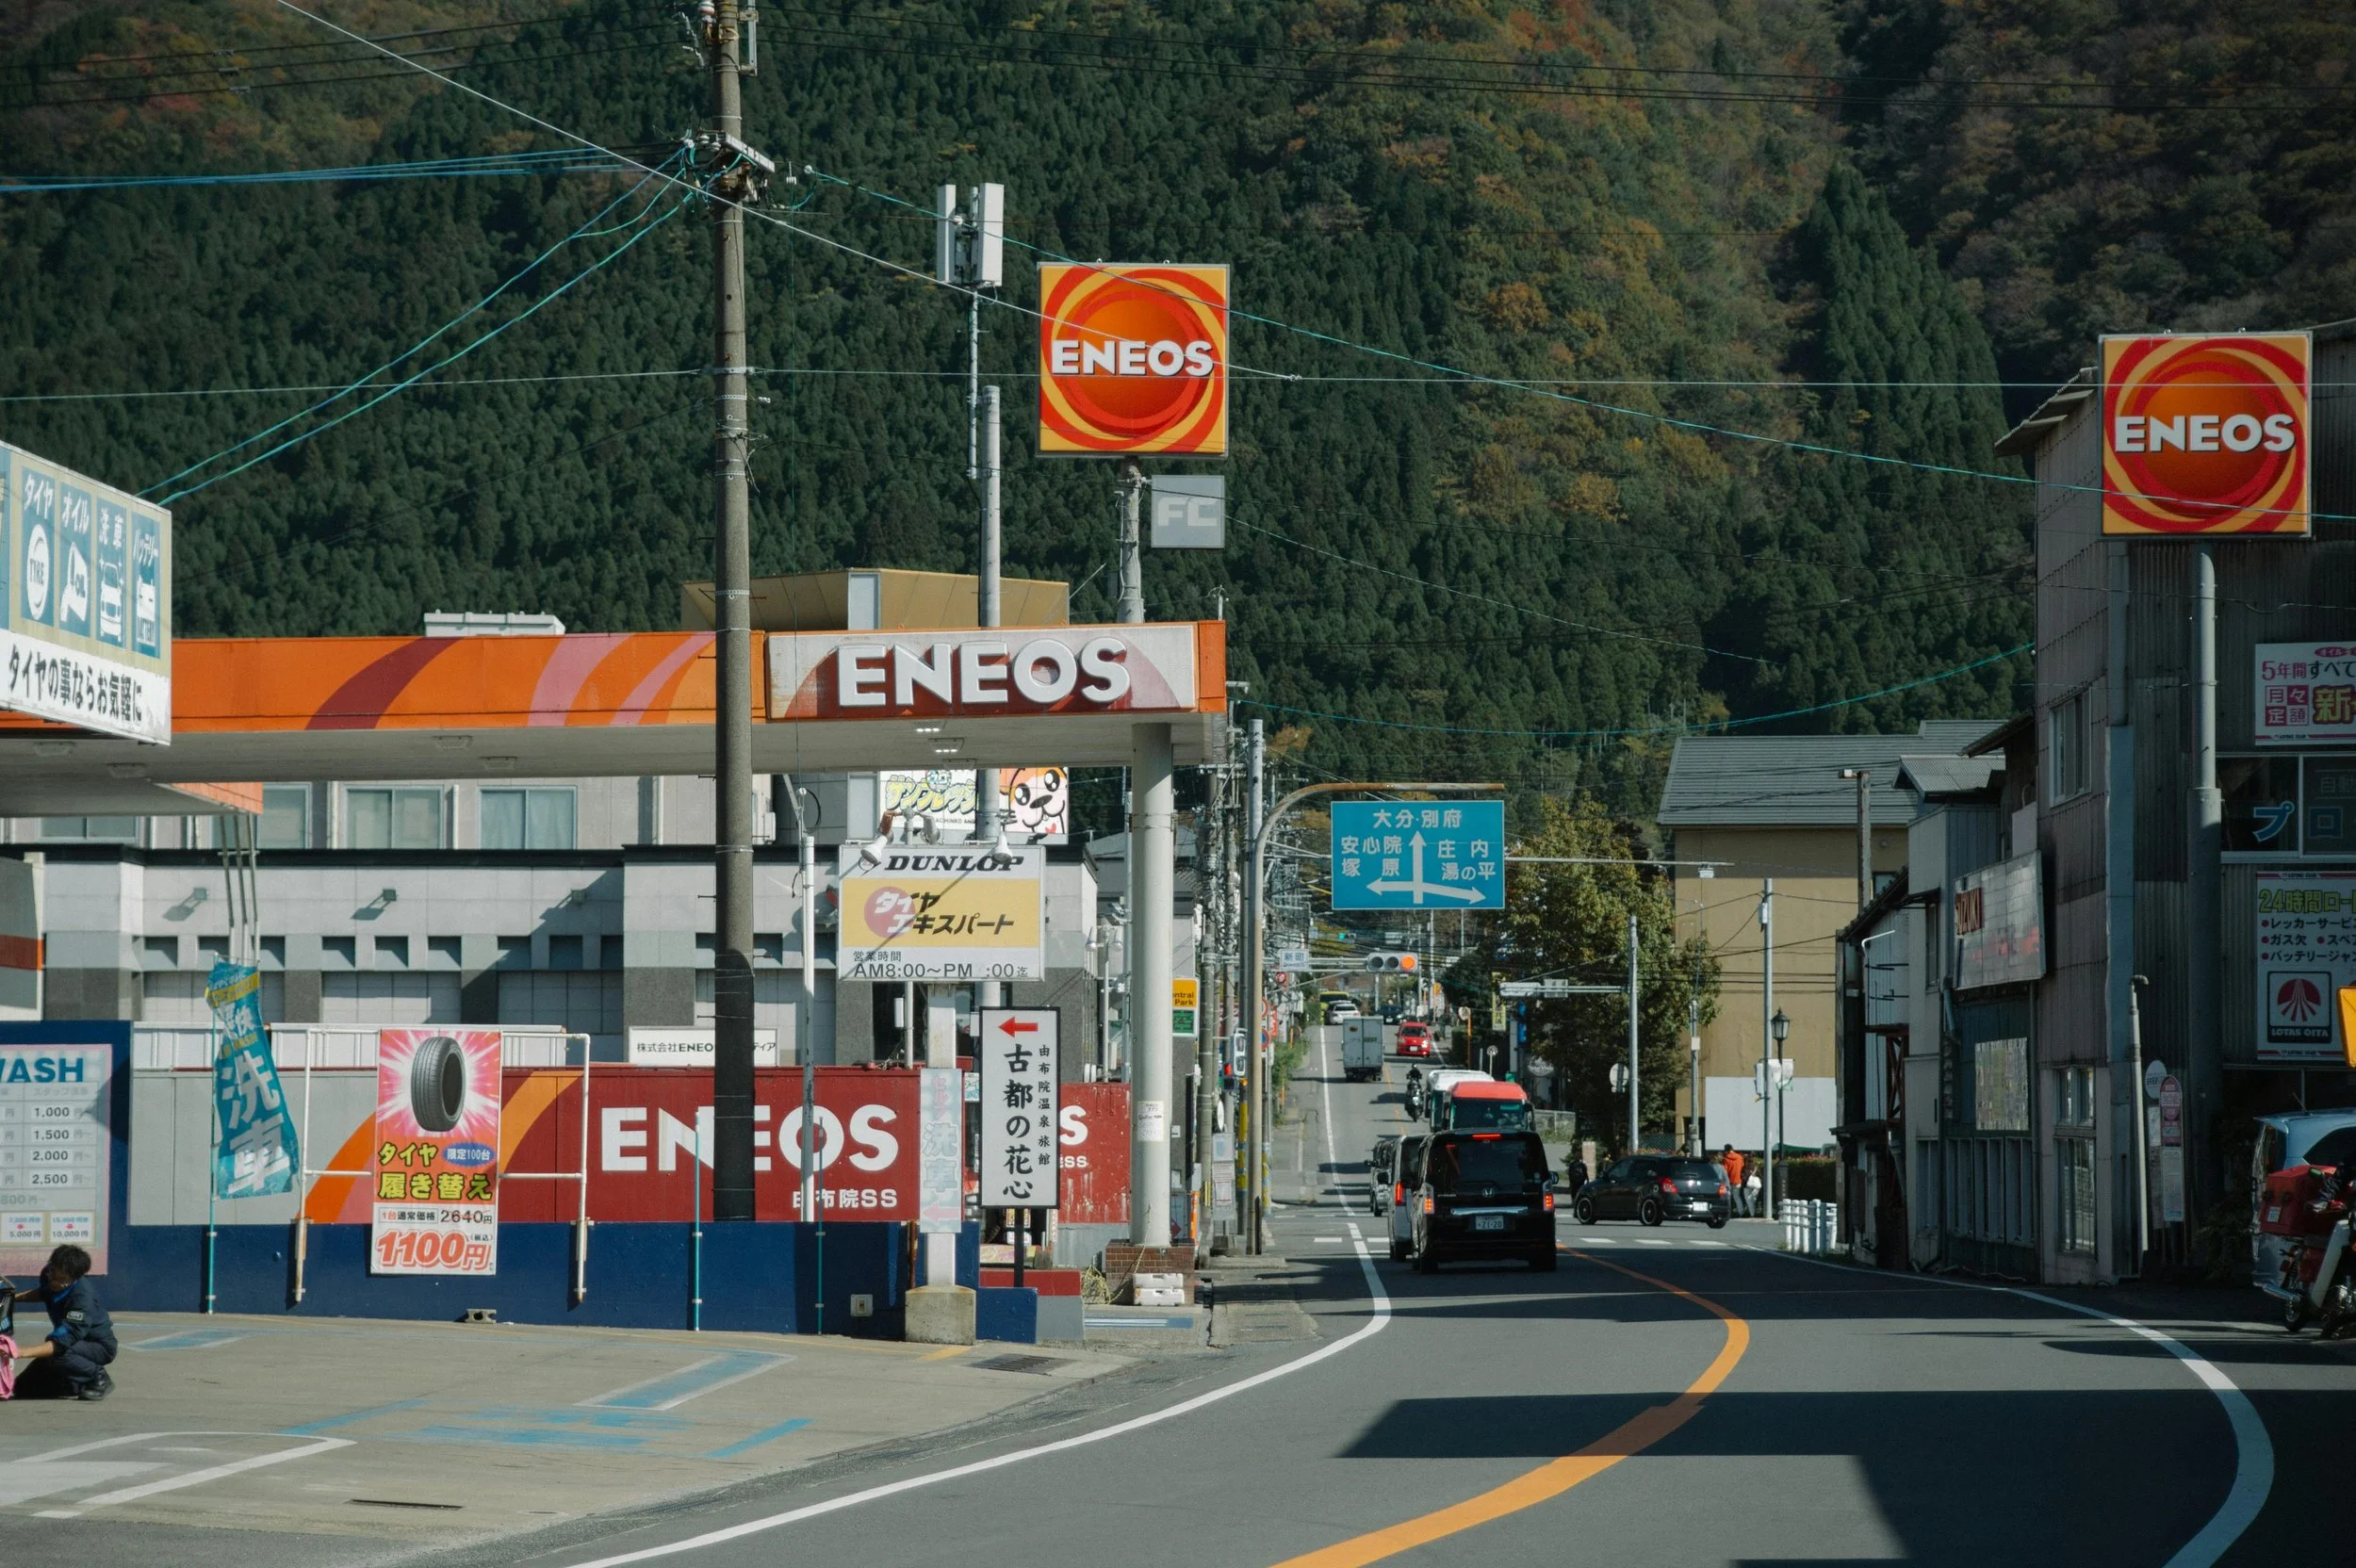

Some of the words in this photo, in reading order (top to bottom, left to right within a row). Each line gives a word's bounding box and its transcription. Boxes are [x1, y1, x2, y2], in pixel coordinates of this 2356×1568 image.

[1050, 339, 1214, 377] ENEOS
[2116, 414, 2296, 452] ENEOS
[25, 474, 54, 519] タイヤ
[62, 492, 90, 534] オイル
[1159, 497, 1218, 526] FC
[99, 507, 124, 549] 洗車
[29, 558, 45, 585] TYRE
[9, 643, 142, 722] タイヤの事ならお気軽に
[835, 636, 1132, 708] ENEOS
[2313, 685, 2356, 724] 新
[1341, 835, 1403, 855] 安心院
[1437, 839, 1489, 858] 庄内
[884, 855, 1024, 872] DUNLOP
[1342, 858, 1400, 876] 塚原
[1442, 861, 1497, 880] 湯の平
[875, 890, 941, 913] タイヤ
[2258, 889, 2356, 913] 24時間ロー
[887, 913, 1014, 935] エキスパート
[2271, 918, 2356, 929] レッカーサービ
[2270, 934, 2307, 946] ガス欠
[853, 951, 902, 962] 営業時間
[1172, 991, 1194, 1000] ntral
[0, 1057, 84, 1084] ASH
[1038, 1044, 1052, 1167] 由布院温泉旅館
[220, 1050, 291, 1194] 洗車
[1003, 1043, 1034, 1200] 古都の花心
[378, 1140, 439, 1168] タイヤ
[447, 1148, 491, 1161] 限定100台
[378, 1171, 493, 1200] 履き替え
[382, 1210, 436, 1221] 1台通常価格
[440, 1210, 493, 1224] 2640円
[377, 1229, 491, 1270] 1100円
